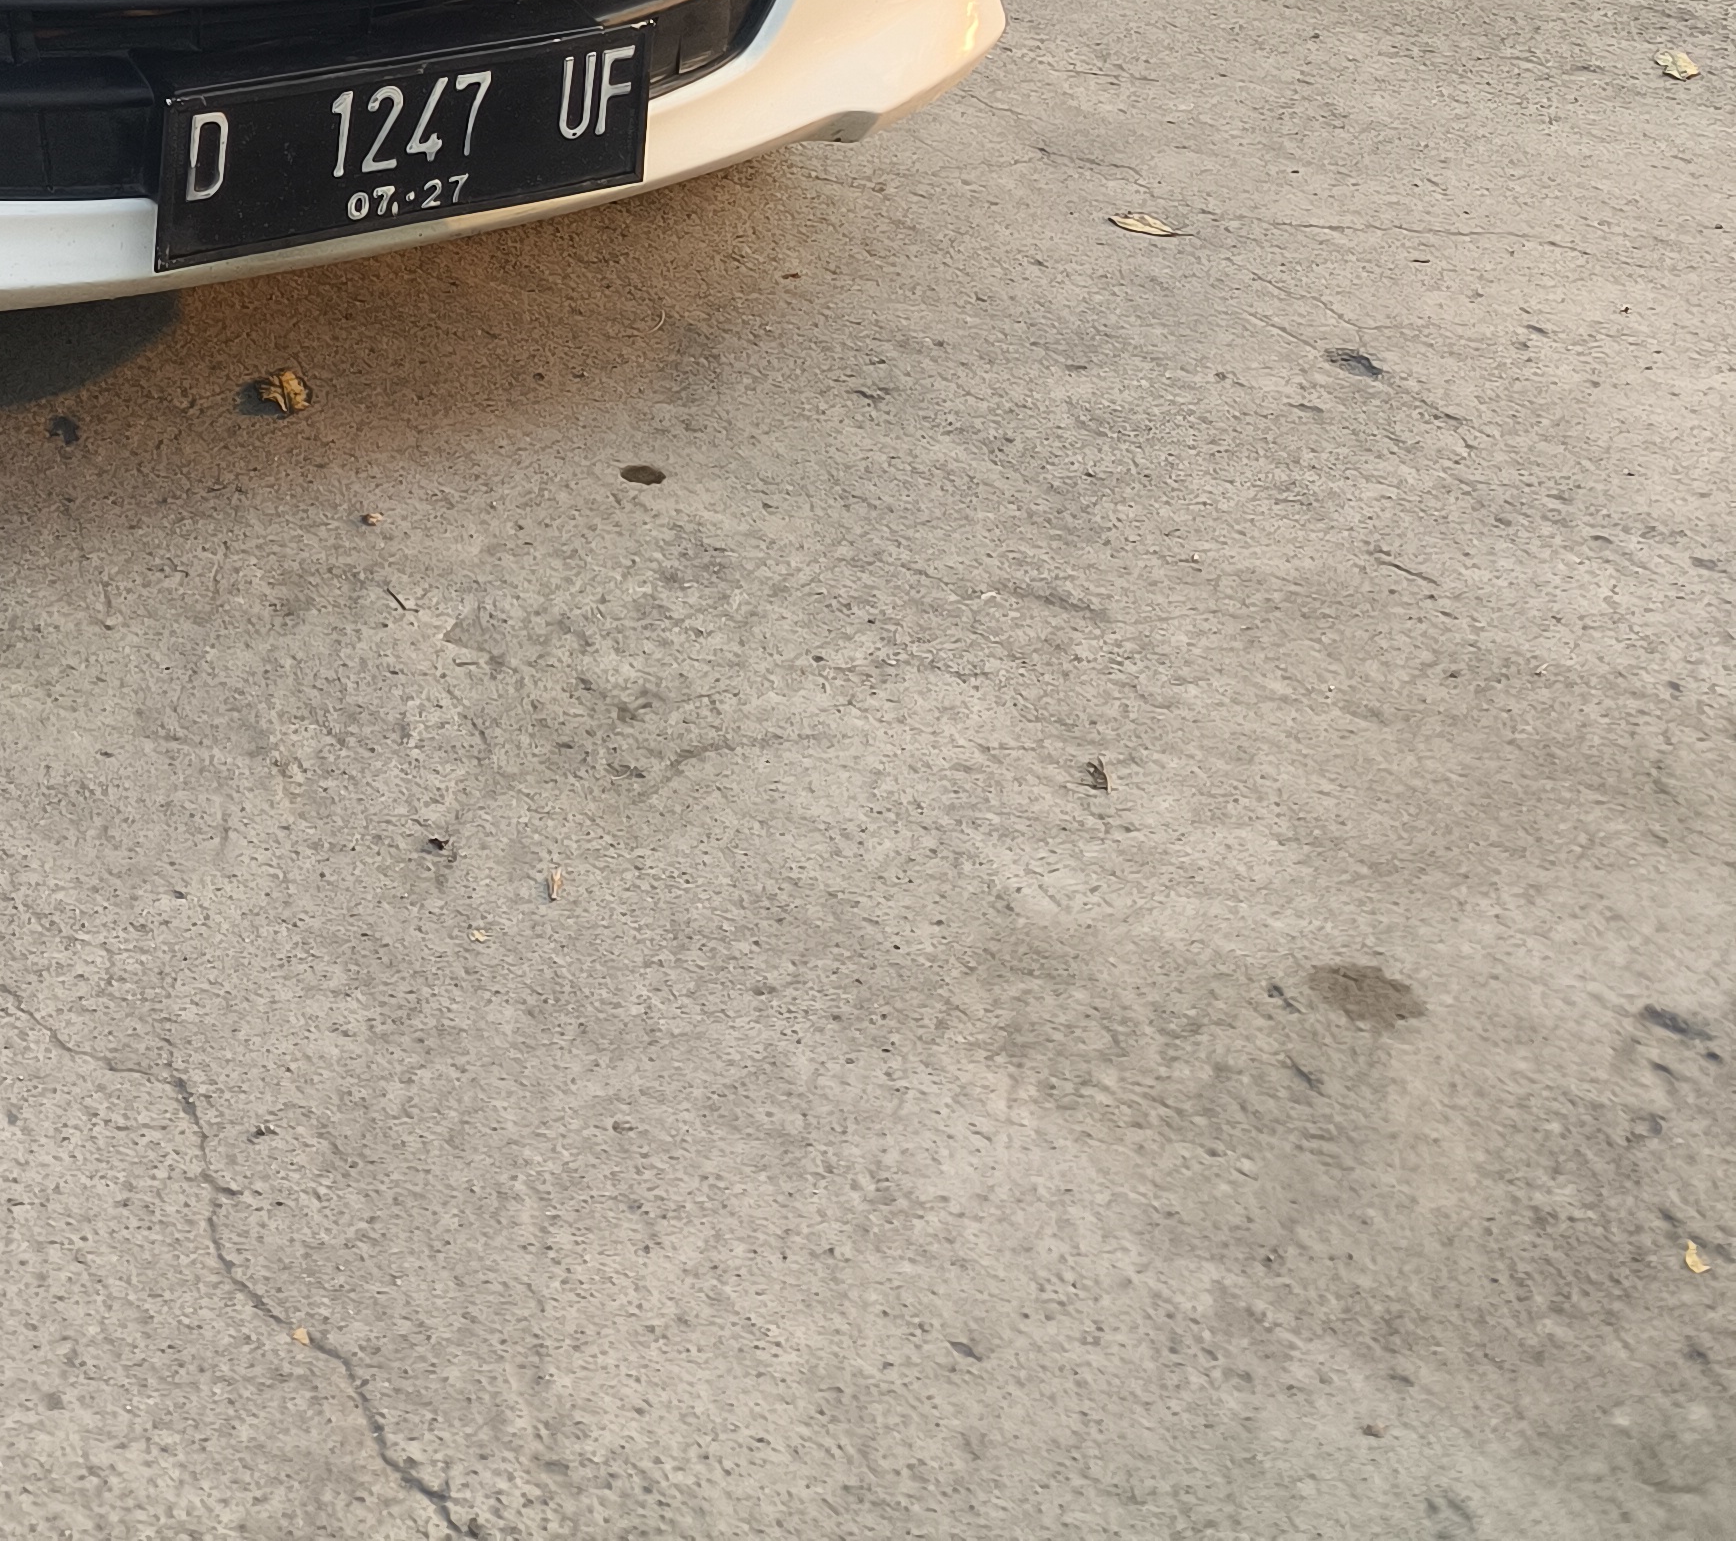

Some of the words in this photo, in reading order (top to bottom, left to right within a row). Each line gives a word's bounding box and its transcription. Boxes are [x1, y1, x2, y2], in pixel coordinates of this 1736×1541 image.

[184, 111, 229, 203] D
[331, 70, 493, 179] 1247
[558, 44, 636, 140] UF
